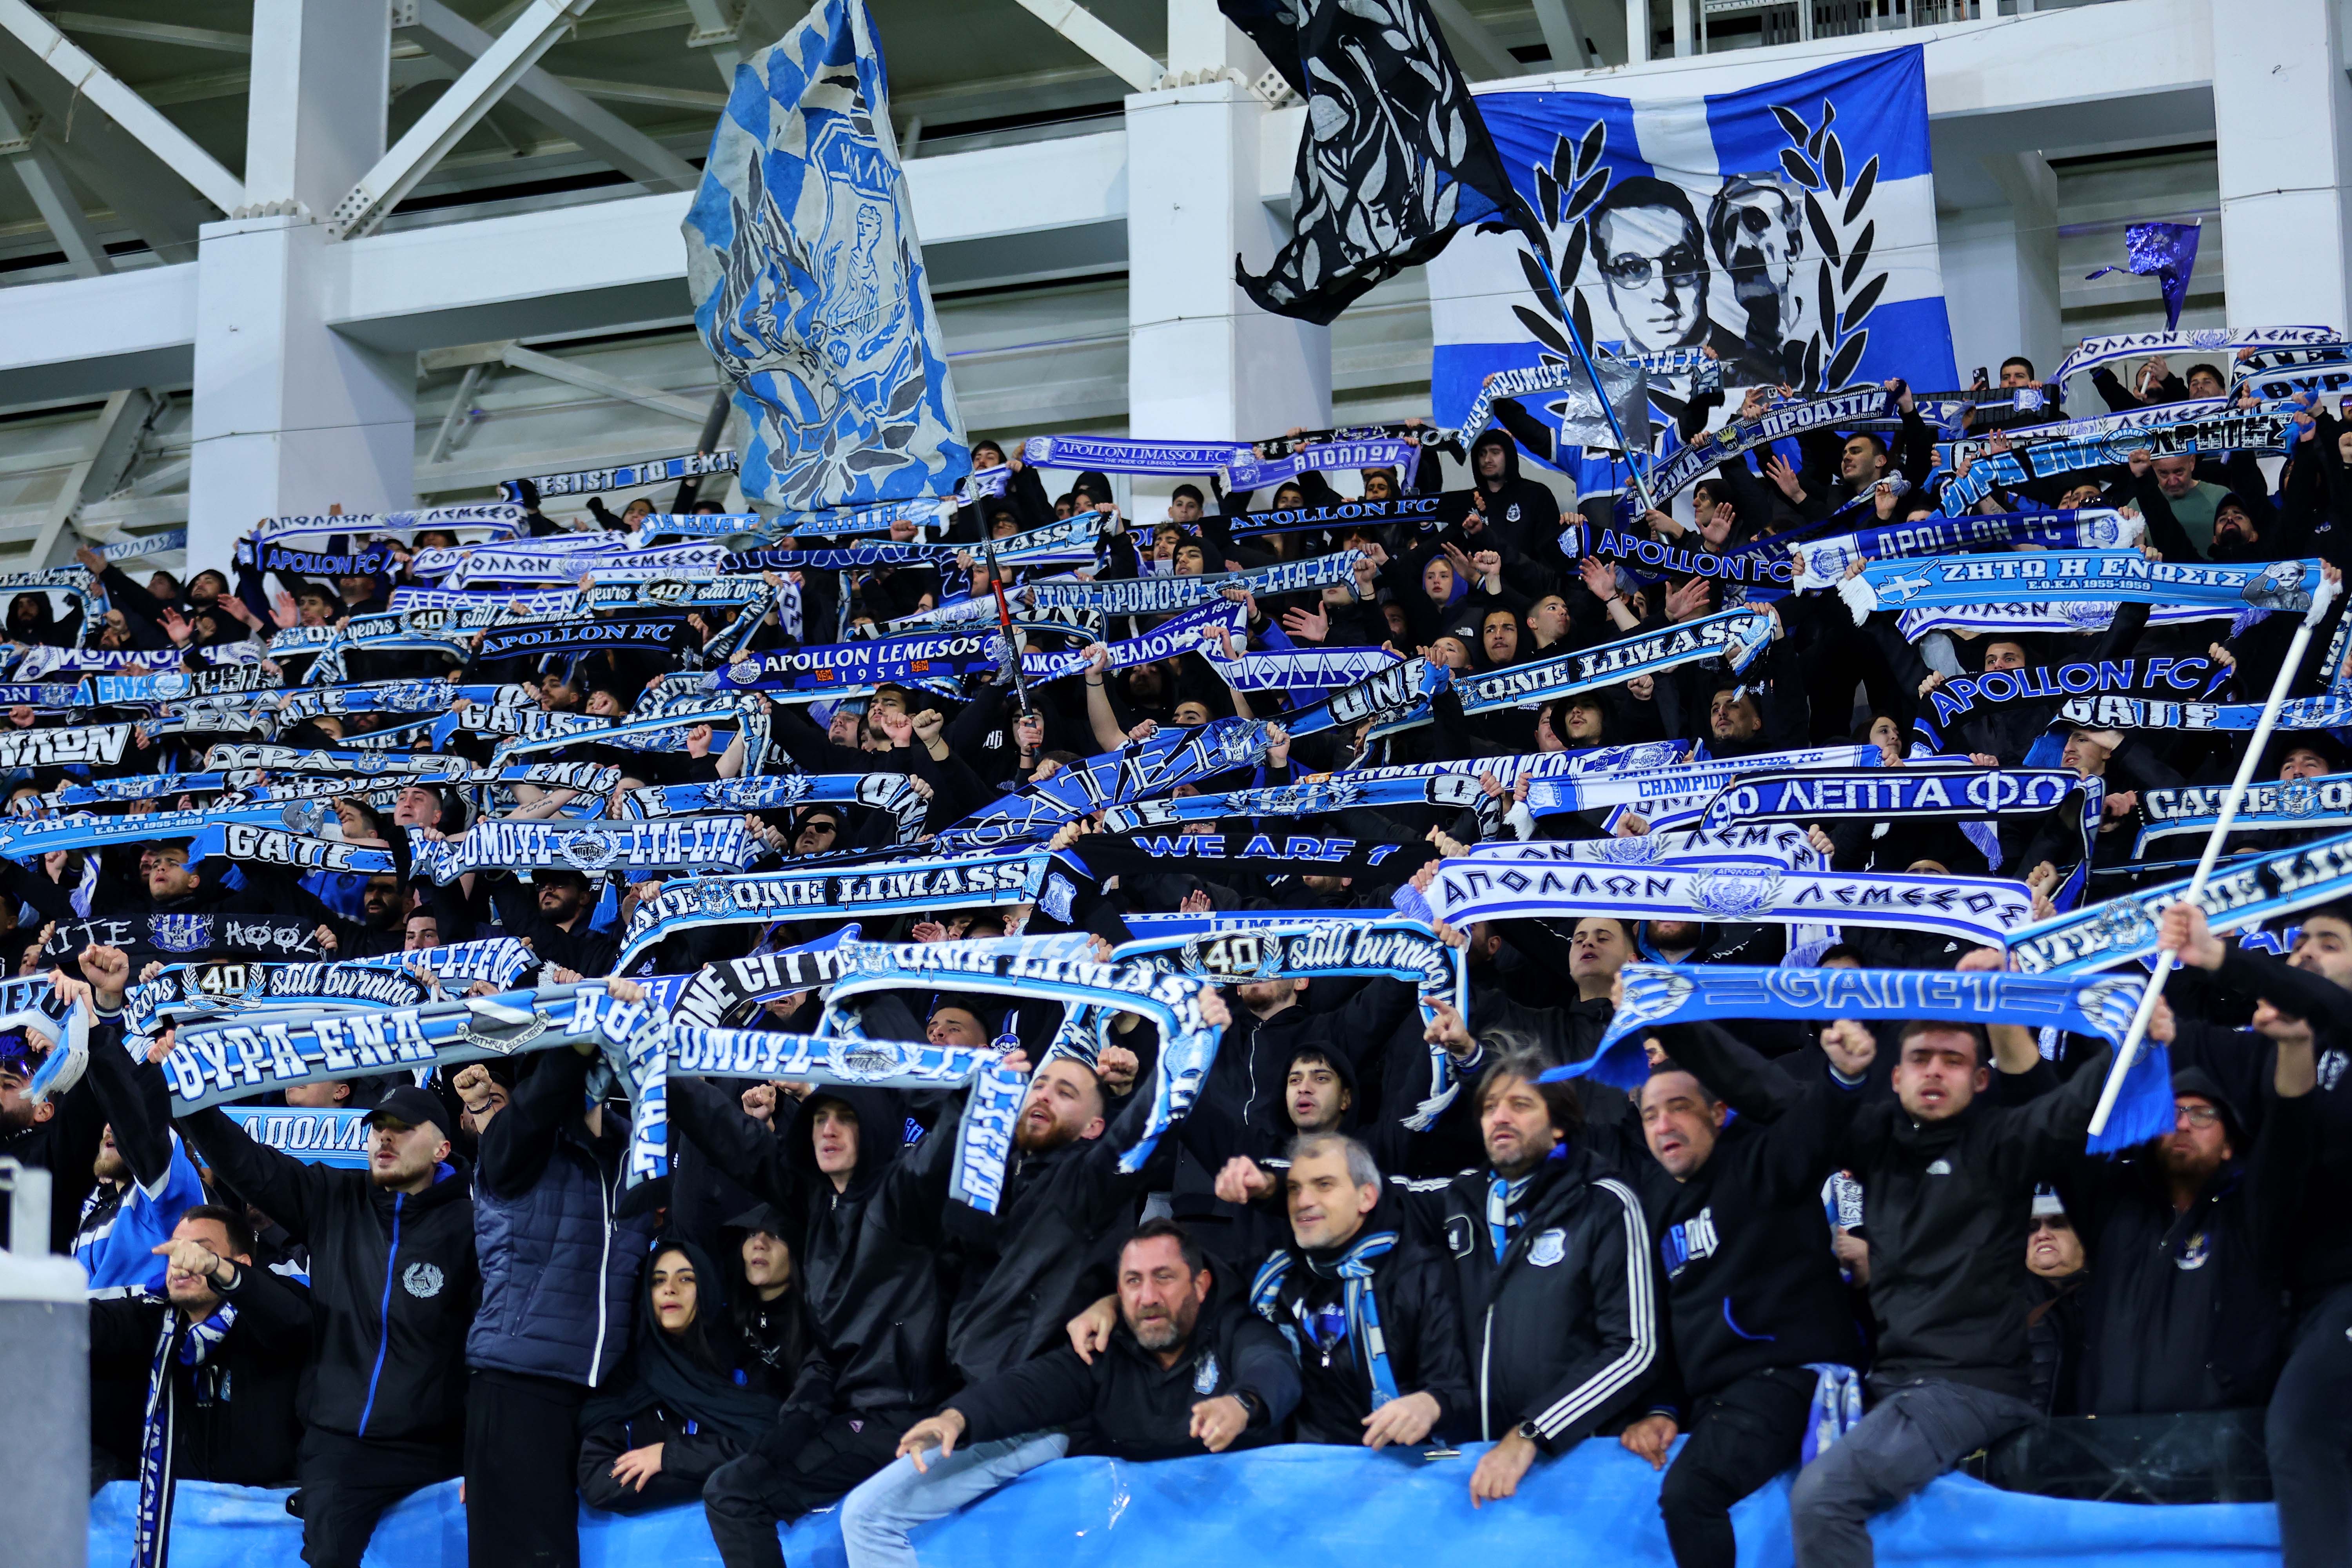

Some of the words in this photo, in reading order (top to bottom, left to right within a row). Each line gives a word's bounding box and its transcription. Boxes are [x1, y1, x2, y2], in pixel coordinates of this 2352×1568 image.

[2063, 330, 2179, 367] ΠΟΛΛΩΝ
[1763, 392, 1887, 437] ΠΡΟΑΣΤΙΑ
[1058, 442, 1132, 459] APOLLON
[1131, 446, 1205, 462] LIMASSOL
[539, 468, 618, 498] ESIST
[631, 461, 667, 485] TO
[1229, 501, 1390, 531] APOLLON
[1394, 497, 1440, 515] FC
[1597, 527, 1744, 581] APOLLON
[1753, 561, 1793, 583] FC
[1877, 517, 2013, 561] APOLLON
[2026, 515, 2062, 542] FC
[267, 550, 352, 574] APOLLON
[354, 554, 380, 574] FC
[1940, 559, 2047, 583] ΖΗΤΩ
[2058, 558, 2089, 578] Η
[2101, 557, 2247, 588] ΕΝΩΣΙΣ
[649, 584, 683, 599] 40
[2083, 580, 2152, 592] 1955-1959
[412, 611, 444, 629] 40
[480, 623, 627, 655] APOLLON
[631, 622, 676, 643] FC
[765, 644, 872, 672] APOLLON
[877, 635, 983, 664] LEMESOS
[1478, 661, 1569, 702] ONE
[1578, 617, 1753, 683] LIMASS
[1930, 659, 2135, 728] APOLLON
[2143, 657, 2210, 690] FC
[2060, 696, 2218, 730] GATE
[1638, 772, 1735, 798] CHAMPION
[1777, 778, 1950, 813] ΛΕΠΤΑ
[143, 817, 203, 831] 1955-1959
[227, 824, 358, 872] GATE
[1131, 835, 1227, 859] WE
[1240, 835, 1357, 861] ARE
[730, 879, 827, 917] ONE
[837, 862, 1027, 909] LIMASS
[1443, 869, 1673, 909] ΑΠΟΛΛΩΝ
[1793, 882, 2027, 929] ΛΕΜΕΣΟΣ
[1205, 938, 1260, 974] 40
[1290, 924, 1354, 969] still
[1352, 922, 1450, 990] burning
[2015, 920, 2113, 974] ATE
[731, 950, 839, 993] CITY
[122, 978, 177, 1036] years
[200, 964, 246, 995] 40
[271, 963, 324, 996] still
[322, 962, 421, 1007] burning
[172, 1020, 310, 1101] ΘΥΡΑ
[311, 1008, 438, 1072] ΕΝΑ
[677, 1025, 813, 1074] ΟΜΟΥΣ
[241, 1116, 372, 1152] ΑΠΟΛΛ
